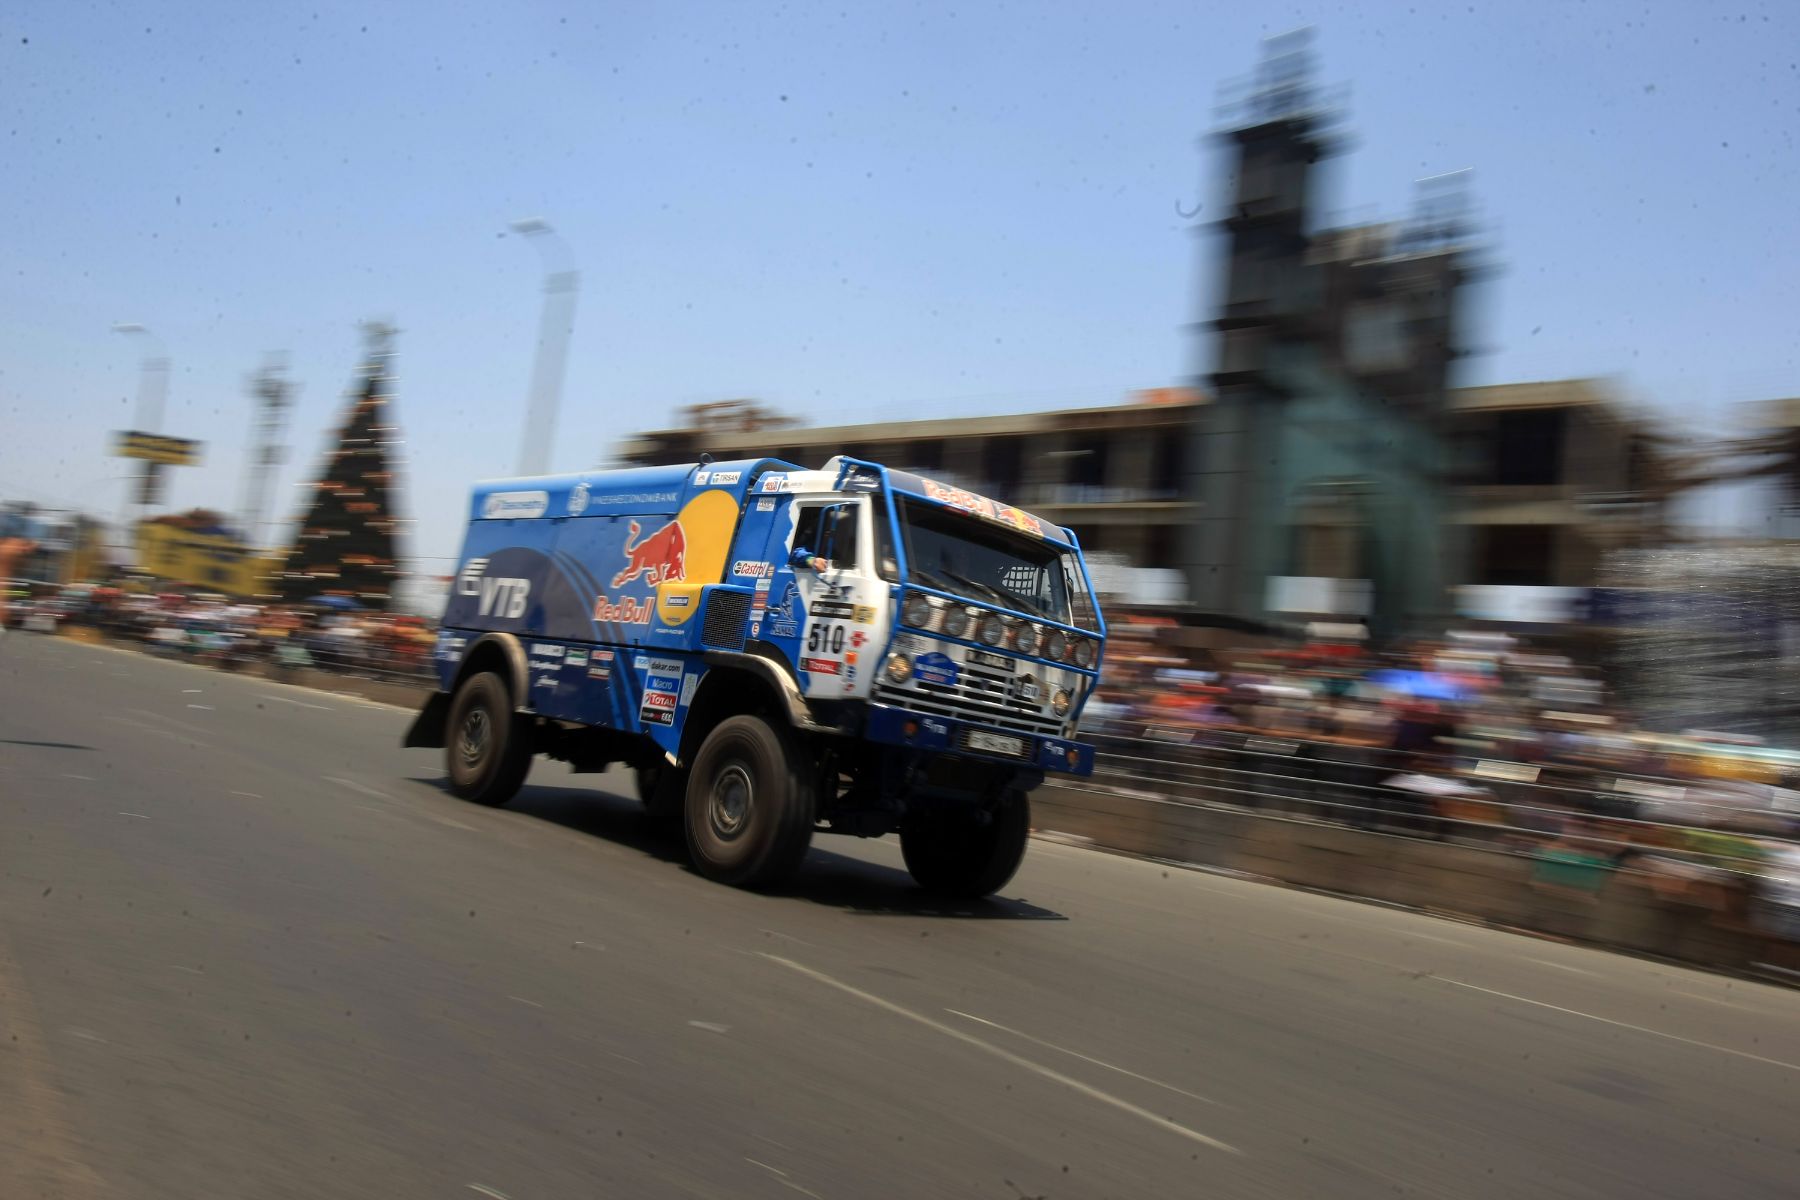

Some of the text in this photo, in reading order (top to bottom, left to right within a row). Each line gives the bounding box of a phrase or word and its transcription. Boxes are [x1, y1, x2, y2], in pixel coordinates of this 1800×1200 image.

[741, 562, 766, 576] Castrol
[479, 577, 531, 618] VTB
[808, 623, 845, 654] 510
[651, 662, 681, 673] dakar.com
[652, 678, 673, 690] Macro
[651, 694, 675, 706] TOTAL
